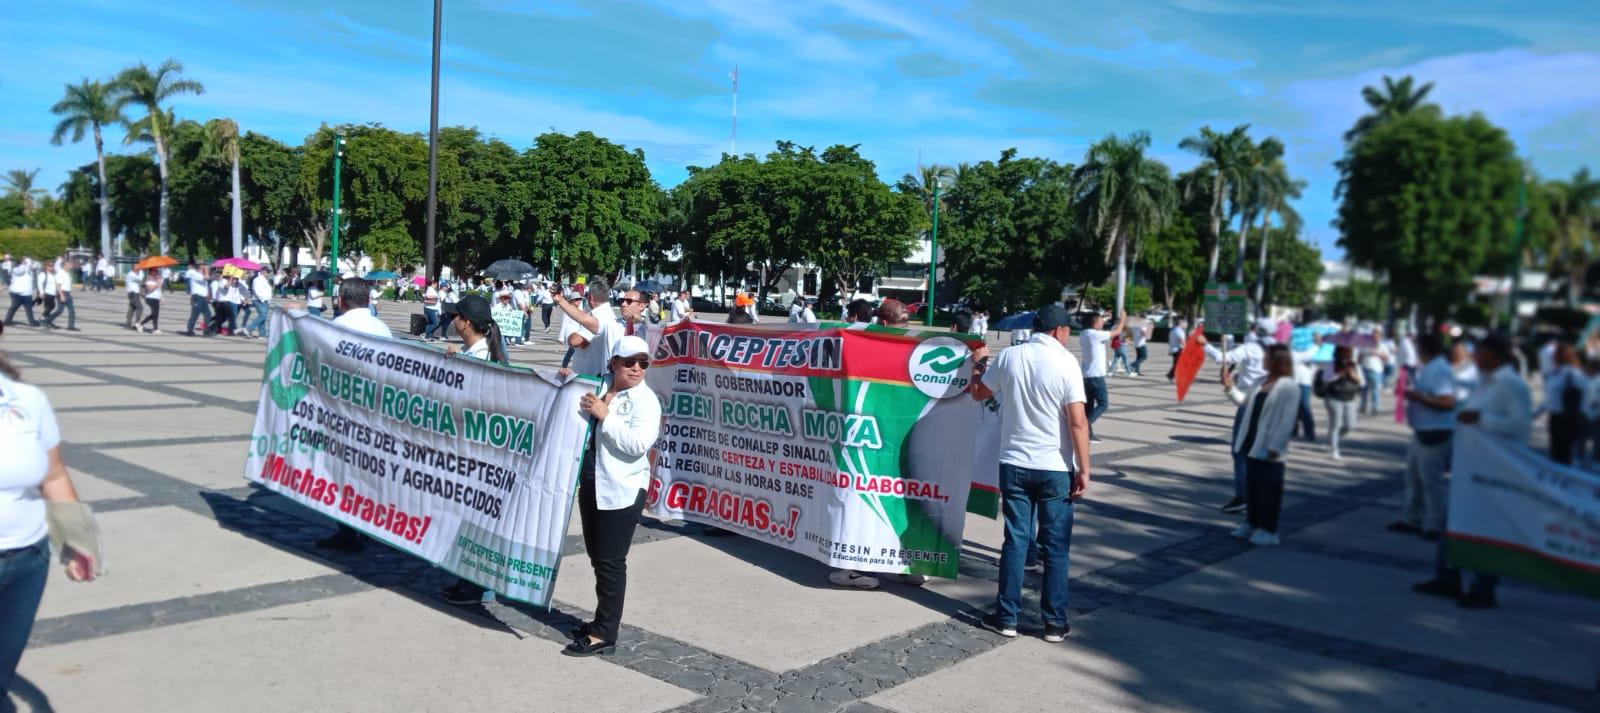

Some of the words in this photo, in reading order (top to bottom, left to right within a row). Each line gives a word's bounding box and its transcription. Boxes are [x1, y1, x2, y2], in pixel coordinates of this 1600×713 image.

[336, 340, 375, 364] SEÑOR
[377, 352, 465, 390] GOBERNADOR
[655, 330, 842, 369] SIACEPTESIN
[675, 367, 708, 387] EÑOR
[715, 374, 805, 398] GOBERNADOR
[913, 373, 968, 388] conalep
[320, 364, 377, 410] RUBÉN
[382, 386, 456, 436] ROCHA
[464, 410, 534, 456] MOYA
[661, 387, 713, 419] UBÉN
[721, 400, 793, 435] ROCHA
[804, 411, 881, 447] MOYA
[290, 423, 386, 477] COMPROMETIDOS
[390, 462, 399, 482] Y
[292, 398, 314, 421] LOS
[317, 407, 372, 446] DOCENTES
[374, 432, 398, 455] DEL
[402, 440, 517, 493] SINTACEPTESIN
[664, 424, 717, 444] DOCENTES
[718, 433, 729, 446] DE
[731, 436, 779, 455] CONALEP
[783, 444, 833, 468] SINALOA,
[657, 456, 671, 469] AL
[675, 458, 722, 478] REGULAR
[725, 468, 742, 484] LAS
[745, 472, 781, 493] HORAS
[785, 480, 814, 500] BASE
[681, 442, 719, 461] DARNOS
[722, 450, 765, 471] CERTEZA
[769, 461, 776, 473] Y
[780, 461, 850, 489] ESTABILIDAD
[855, 476, 949, 502] LABORAL,
[339, 484, 431, 545] Gracias!
[666, 483, 798, 540] GRACIAS..!
[507, 556, 557, 580] PRESENTE
[868, 557, 887, 565] para
[881, 547, 948, 562] PRESENTE
